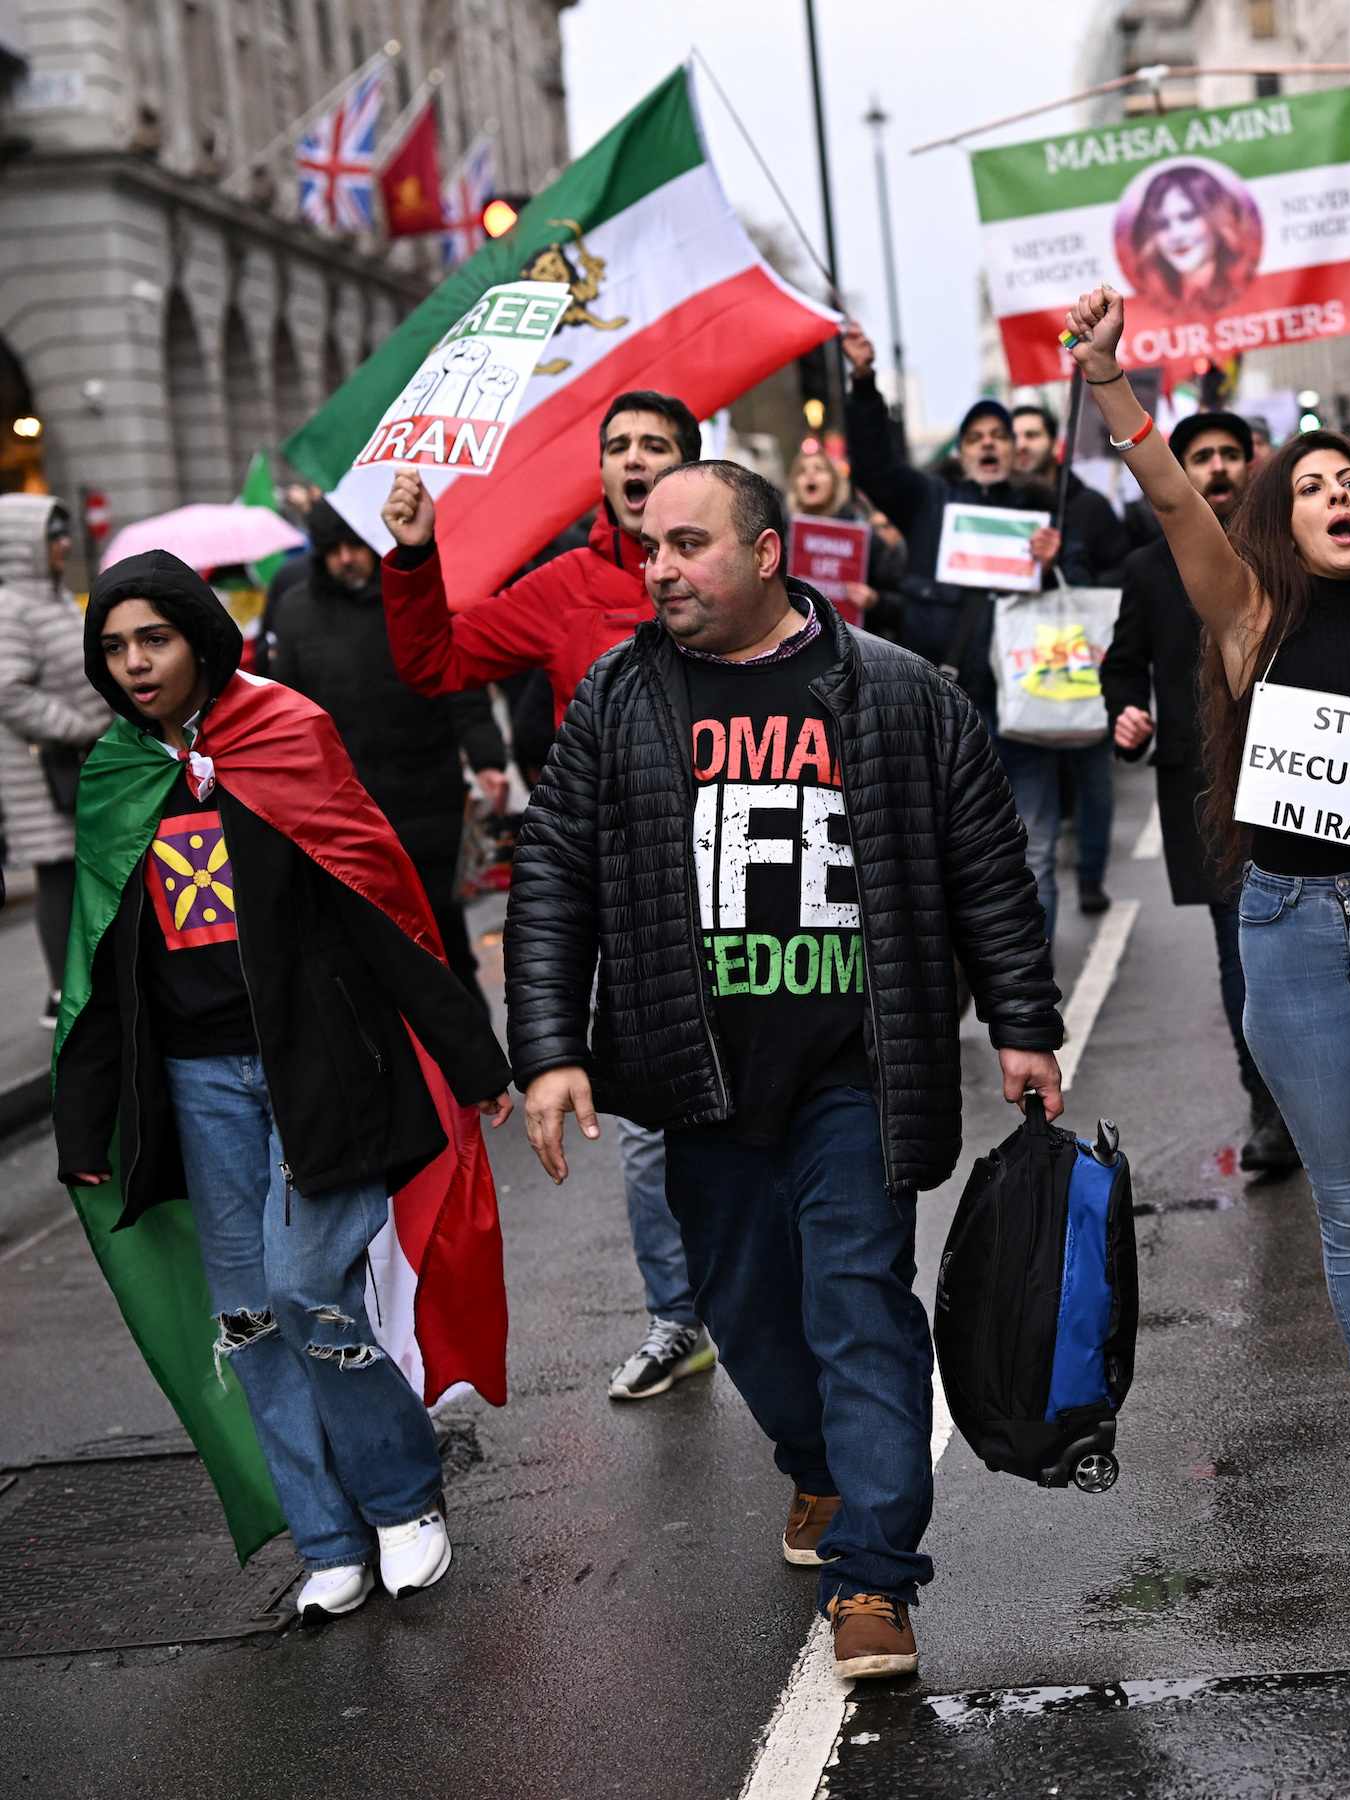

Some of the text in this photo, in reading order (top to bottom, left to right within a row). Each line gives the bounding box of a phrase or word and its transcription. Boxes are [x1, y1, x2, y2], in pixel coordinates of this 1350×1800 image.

[1044, 103, 1293, 173] MAHSA AMINI
[1012, 233, 1087, 262] NEVER
[1004, 258, 1103, 289] FORGIVE
[1132, 323, 1213, 362] OUR
[1214, 300, 1347, 350] SISTERS
[360, 419, 500, 467] IRAN
[691, 715, 842, 786] OMA
[1272, 800, 1306, 830] IN
